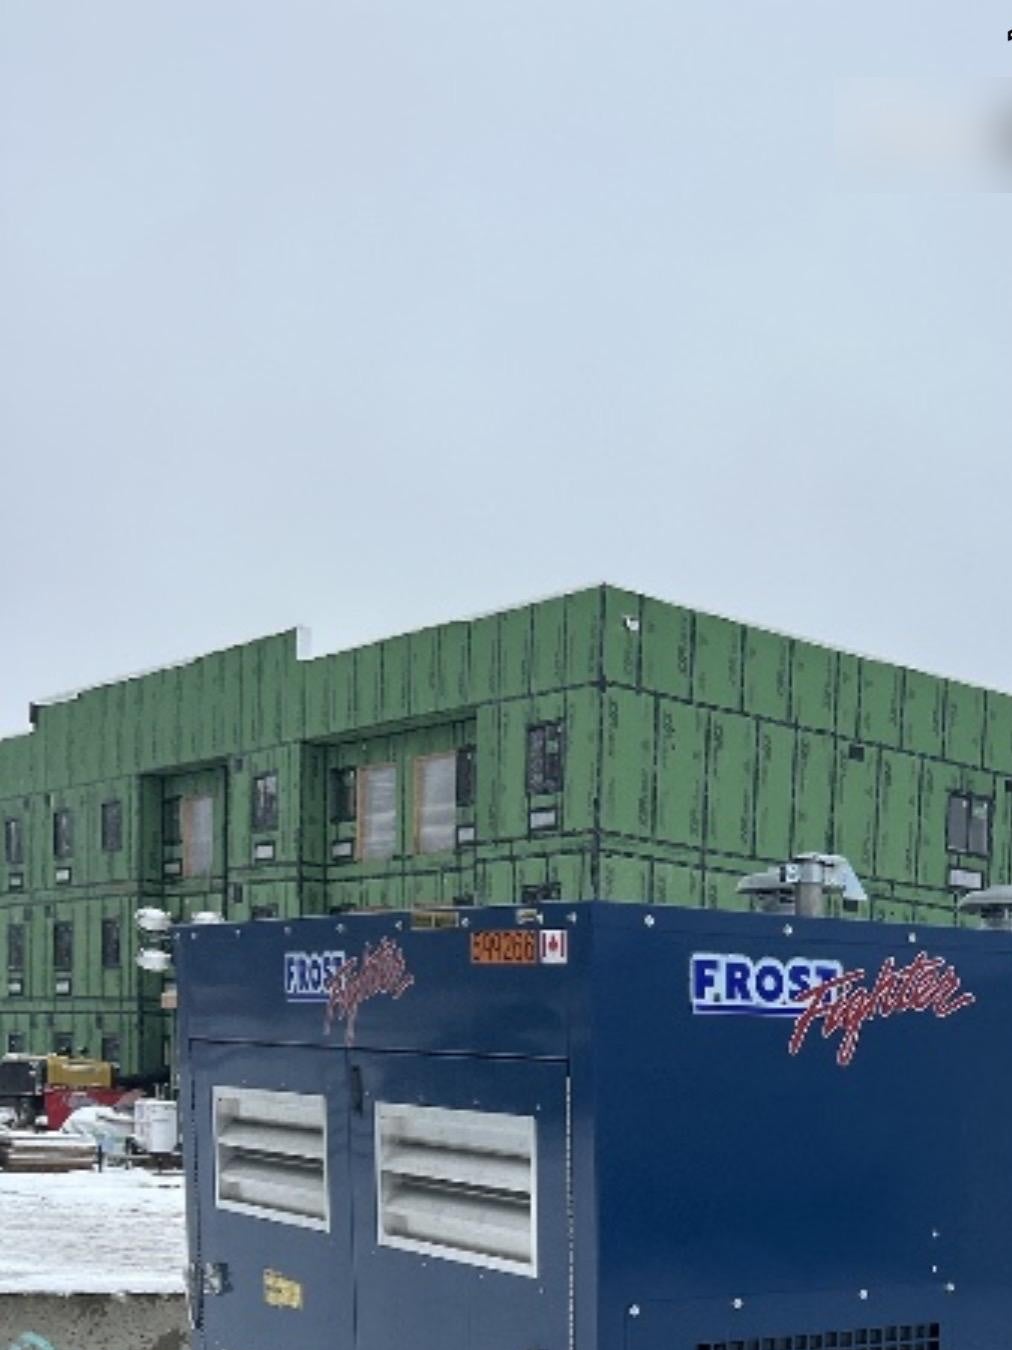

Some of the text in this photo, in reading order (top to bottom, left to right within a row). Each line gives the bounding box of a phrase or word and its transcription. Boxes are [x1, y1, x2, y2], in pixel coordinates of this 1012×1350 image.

[285, 951, 346, 1001] FROST
[690, 953, 843, 1010] FROST
[788, 950, 976, 1066] Fighter
